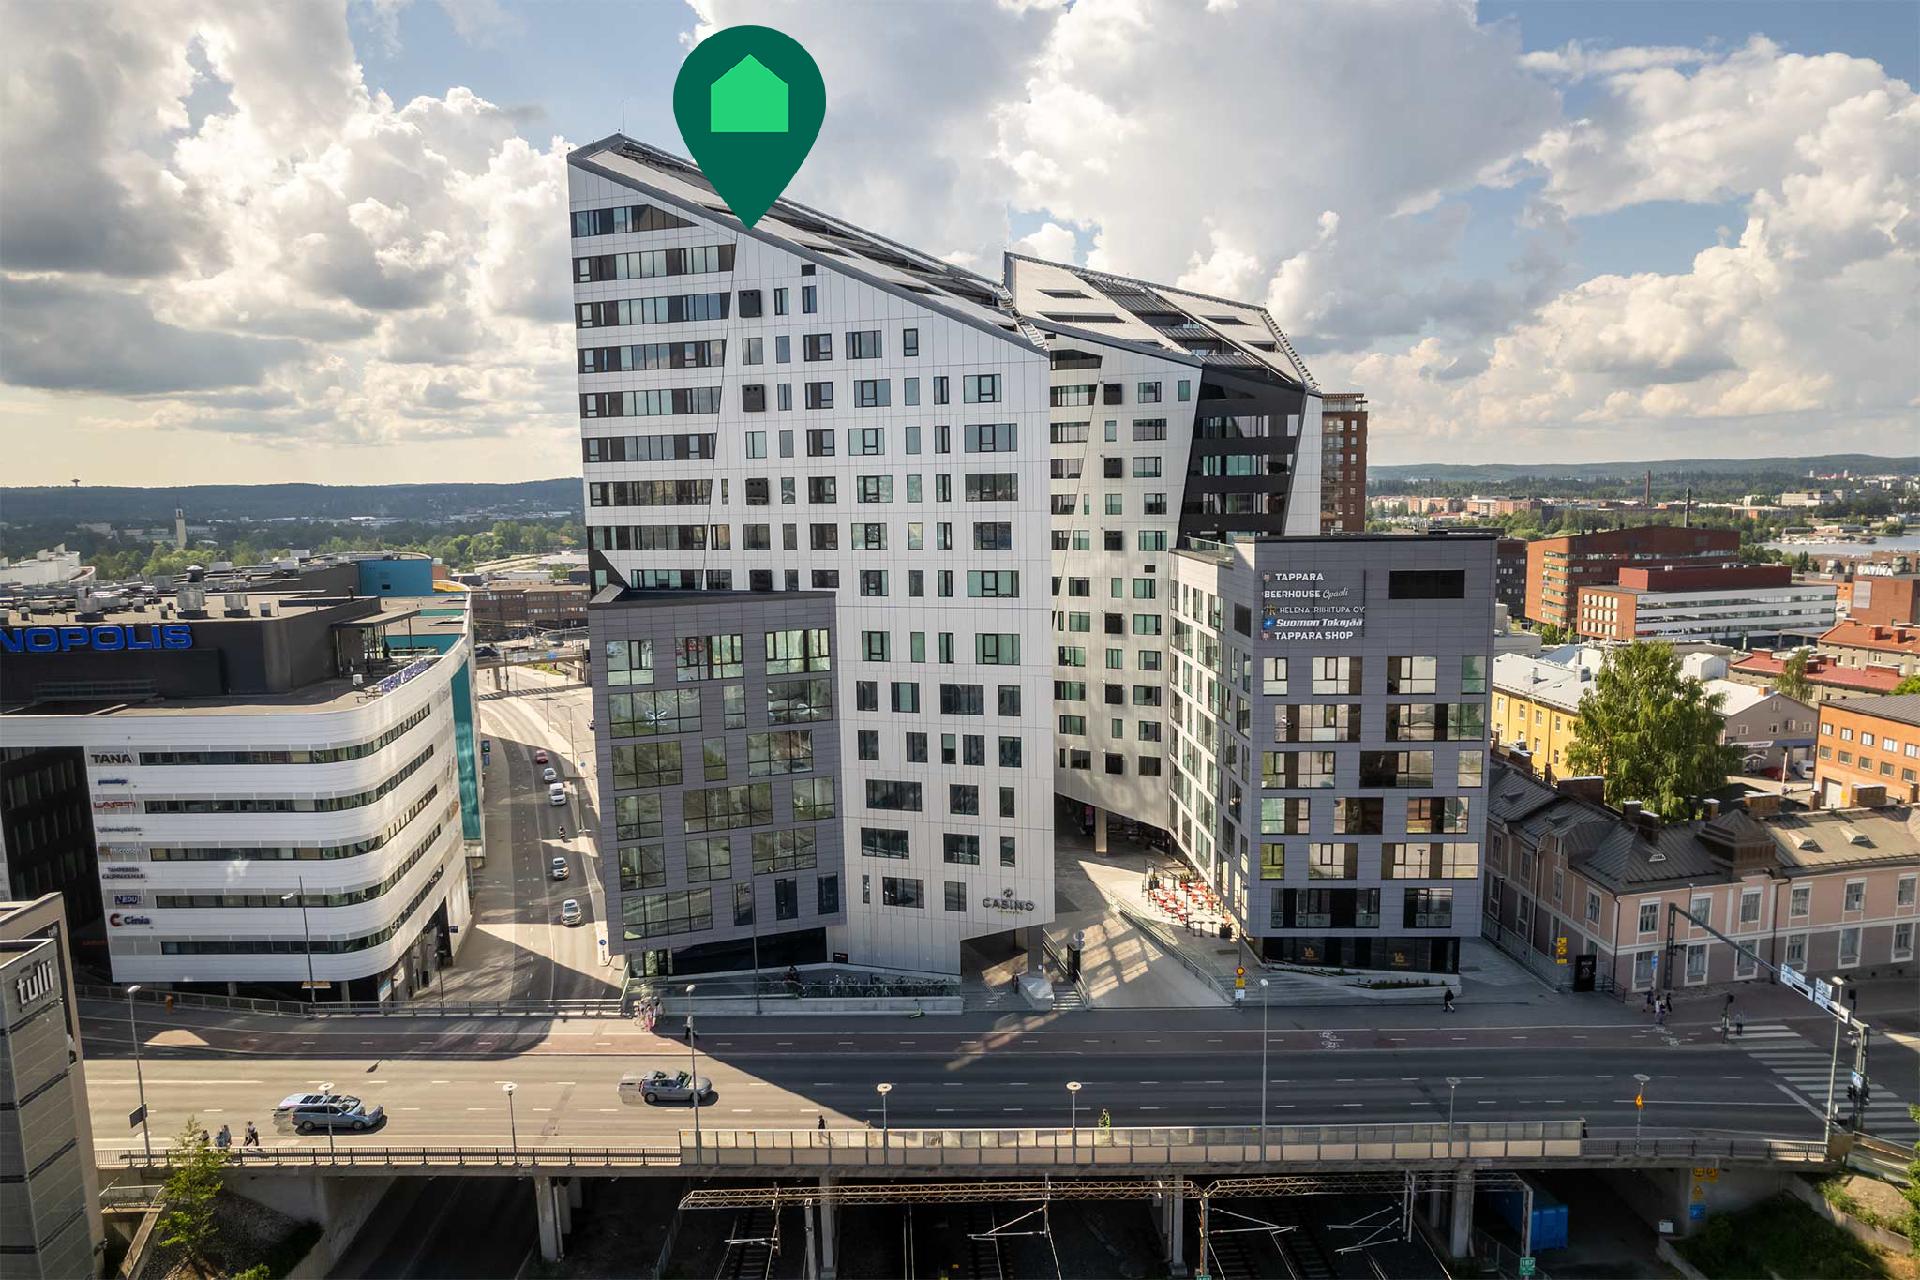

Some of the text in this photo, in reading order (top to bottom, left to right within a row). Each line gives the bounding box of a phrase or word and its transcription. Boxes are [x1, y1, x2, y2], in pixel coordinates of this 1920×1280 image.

[1275, 573, 1324, 581] TAPPARA
[1264, 590, 1321, 598] BEERHOUSE
[1274, 631, 1354, 640] TAPPARA SHOP
[90, 754, 132, 764] TANA
[982, 897, 1035, 911] CASINO
[124, 916, 150, 925] Cinia
[17, 960, 54, 1004] tulli
